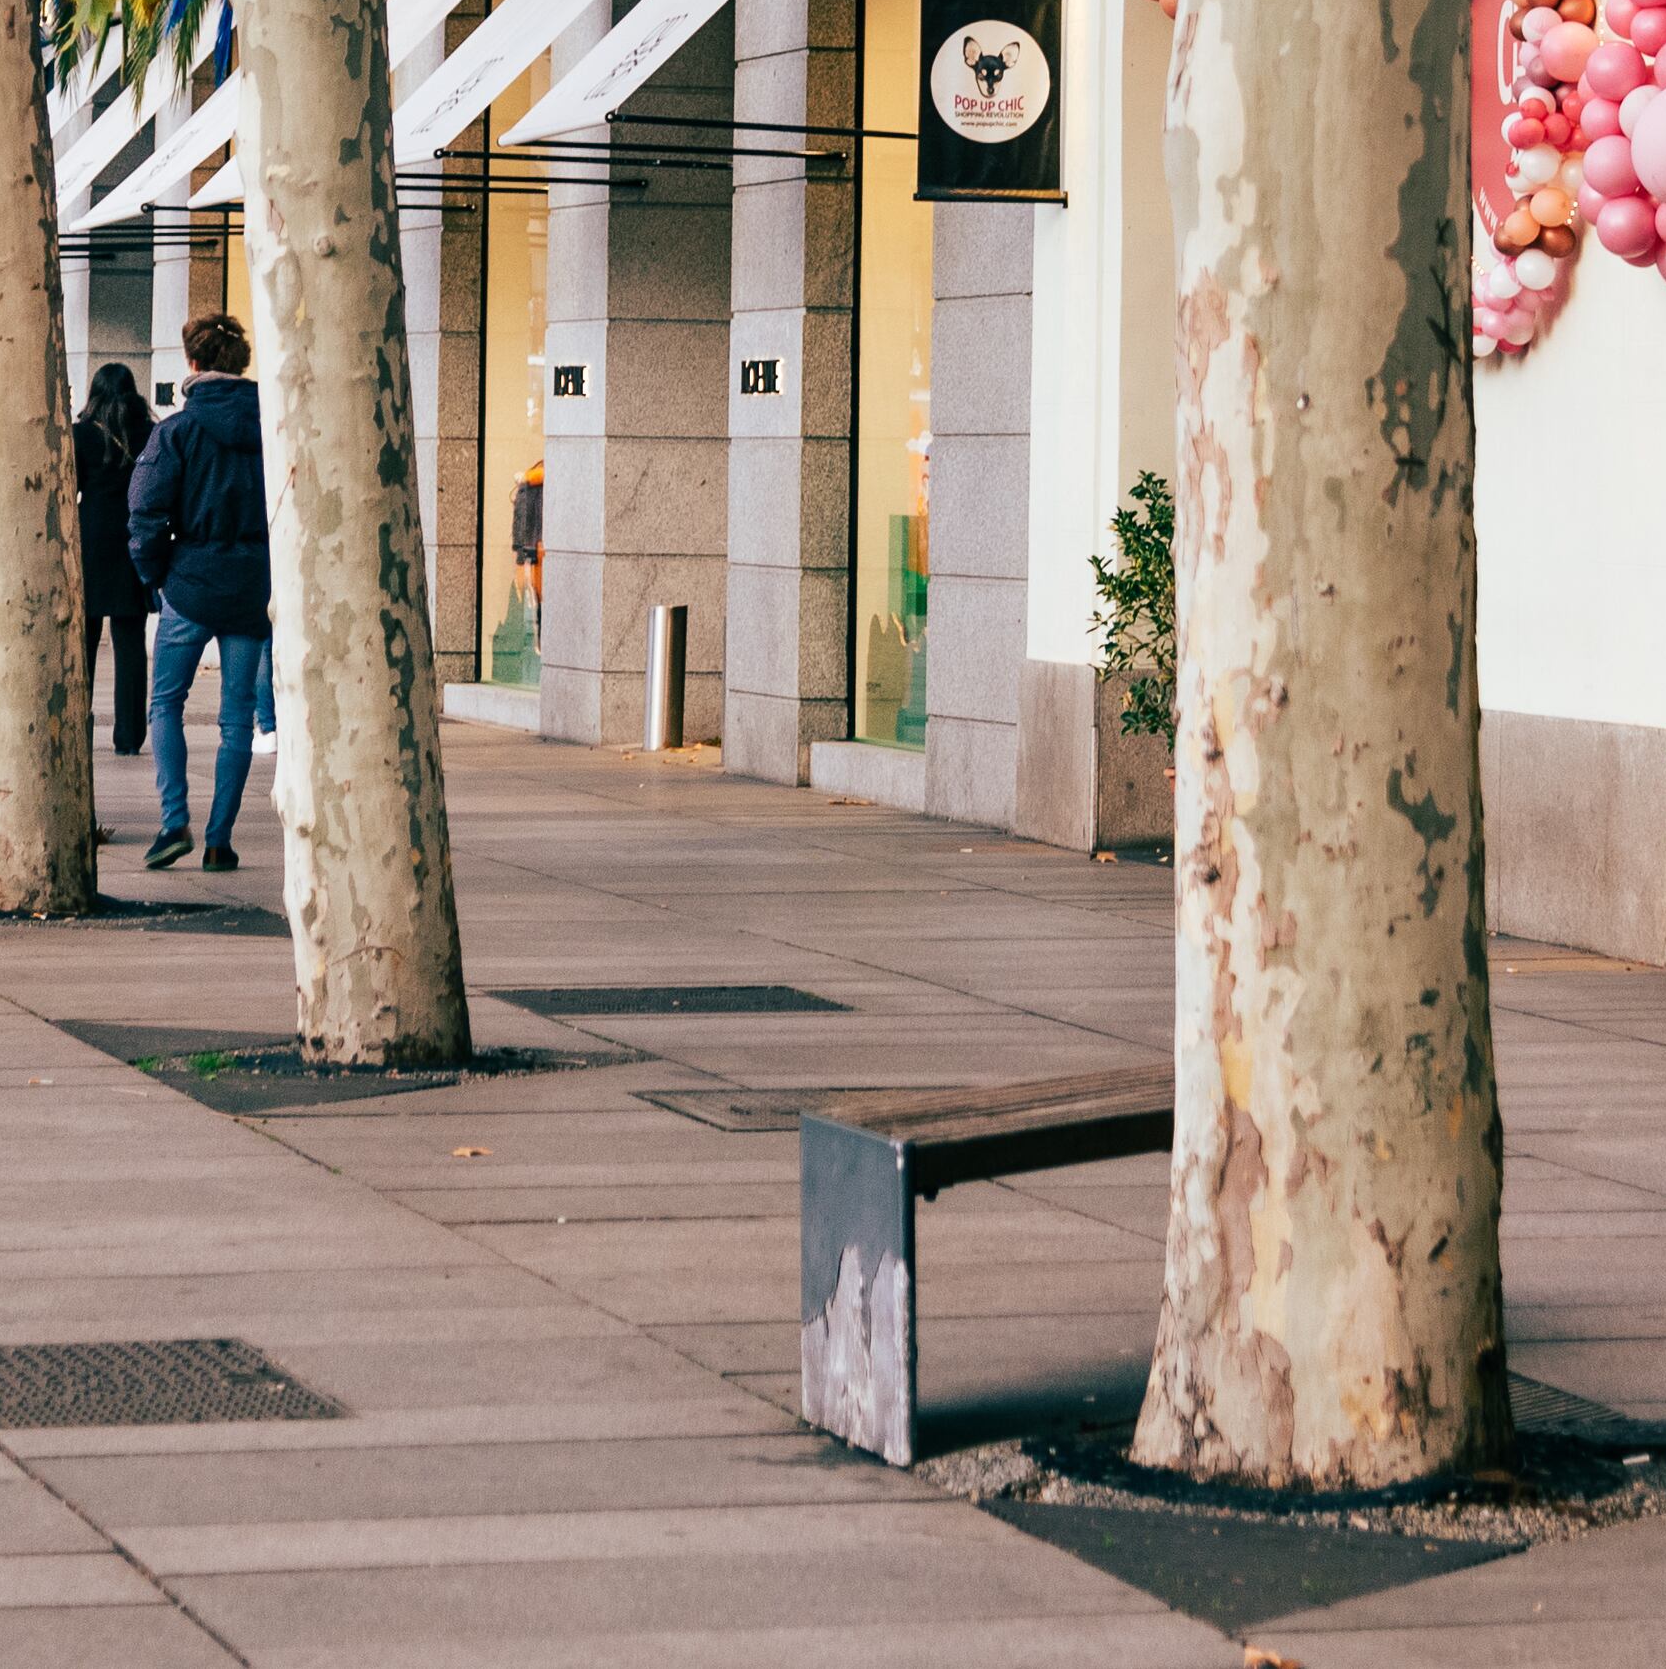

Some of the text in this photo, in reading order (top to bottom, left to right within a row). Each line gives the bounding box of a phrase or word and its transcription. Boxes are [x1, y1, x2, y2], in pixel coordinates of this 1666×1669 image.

[954, 94, 1024, 111] POP UP CHIC
